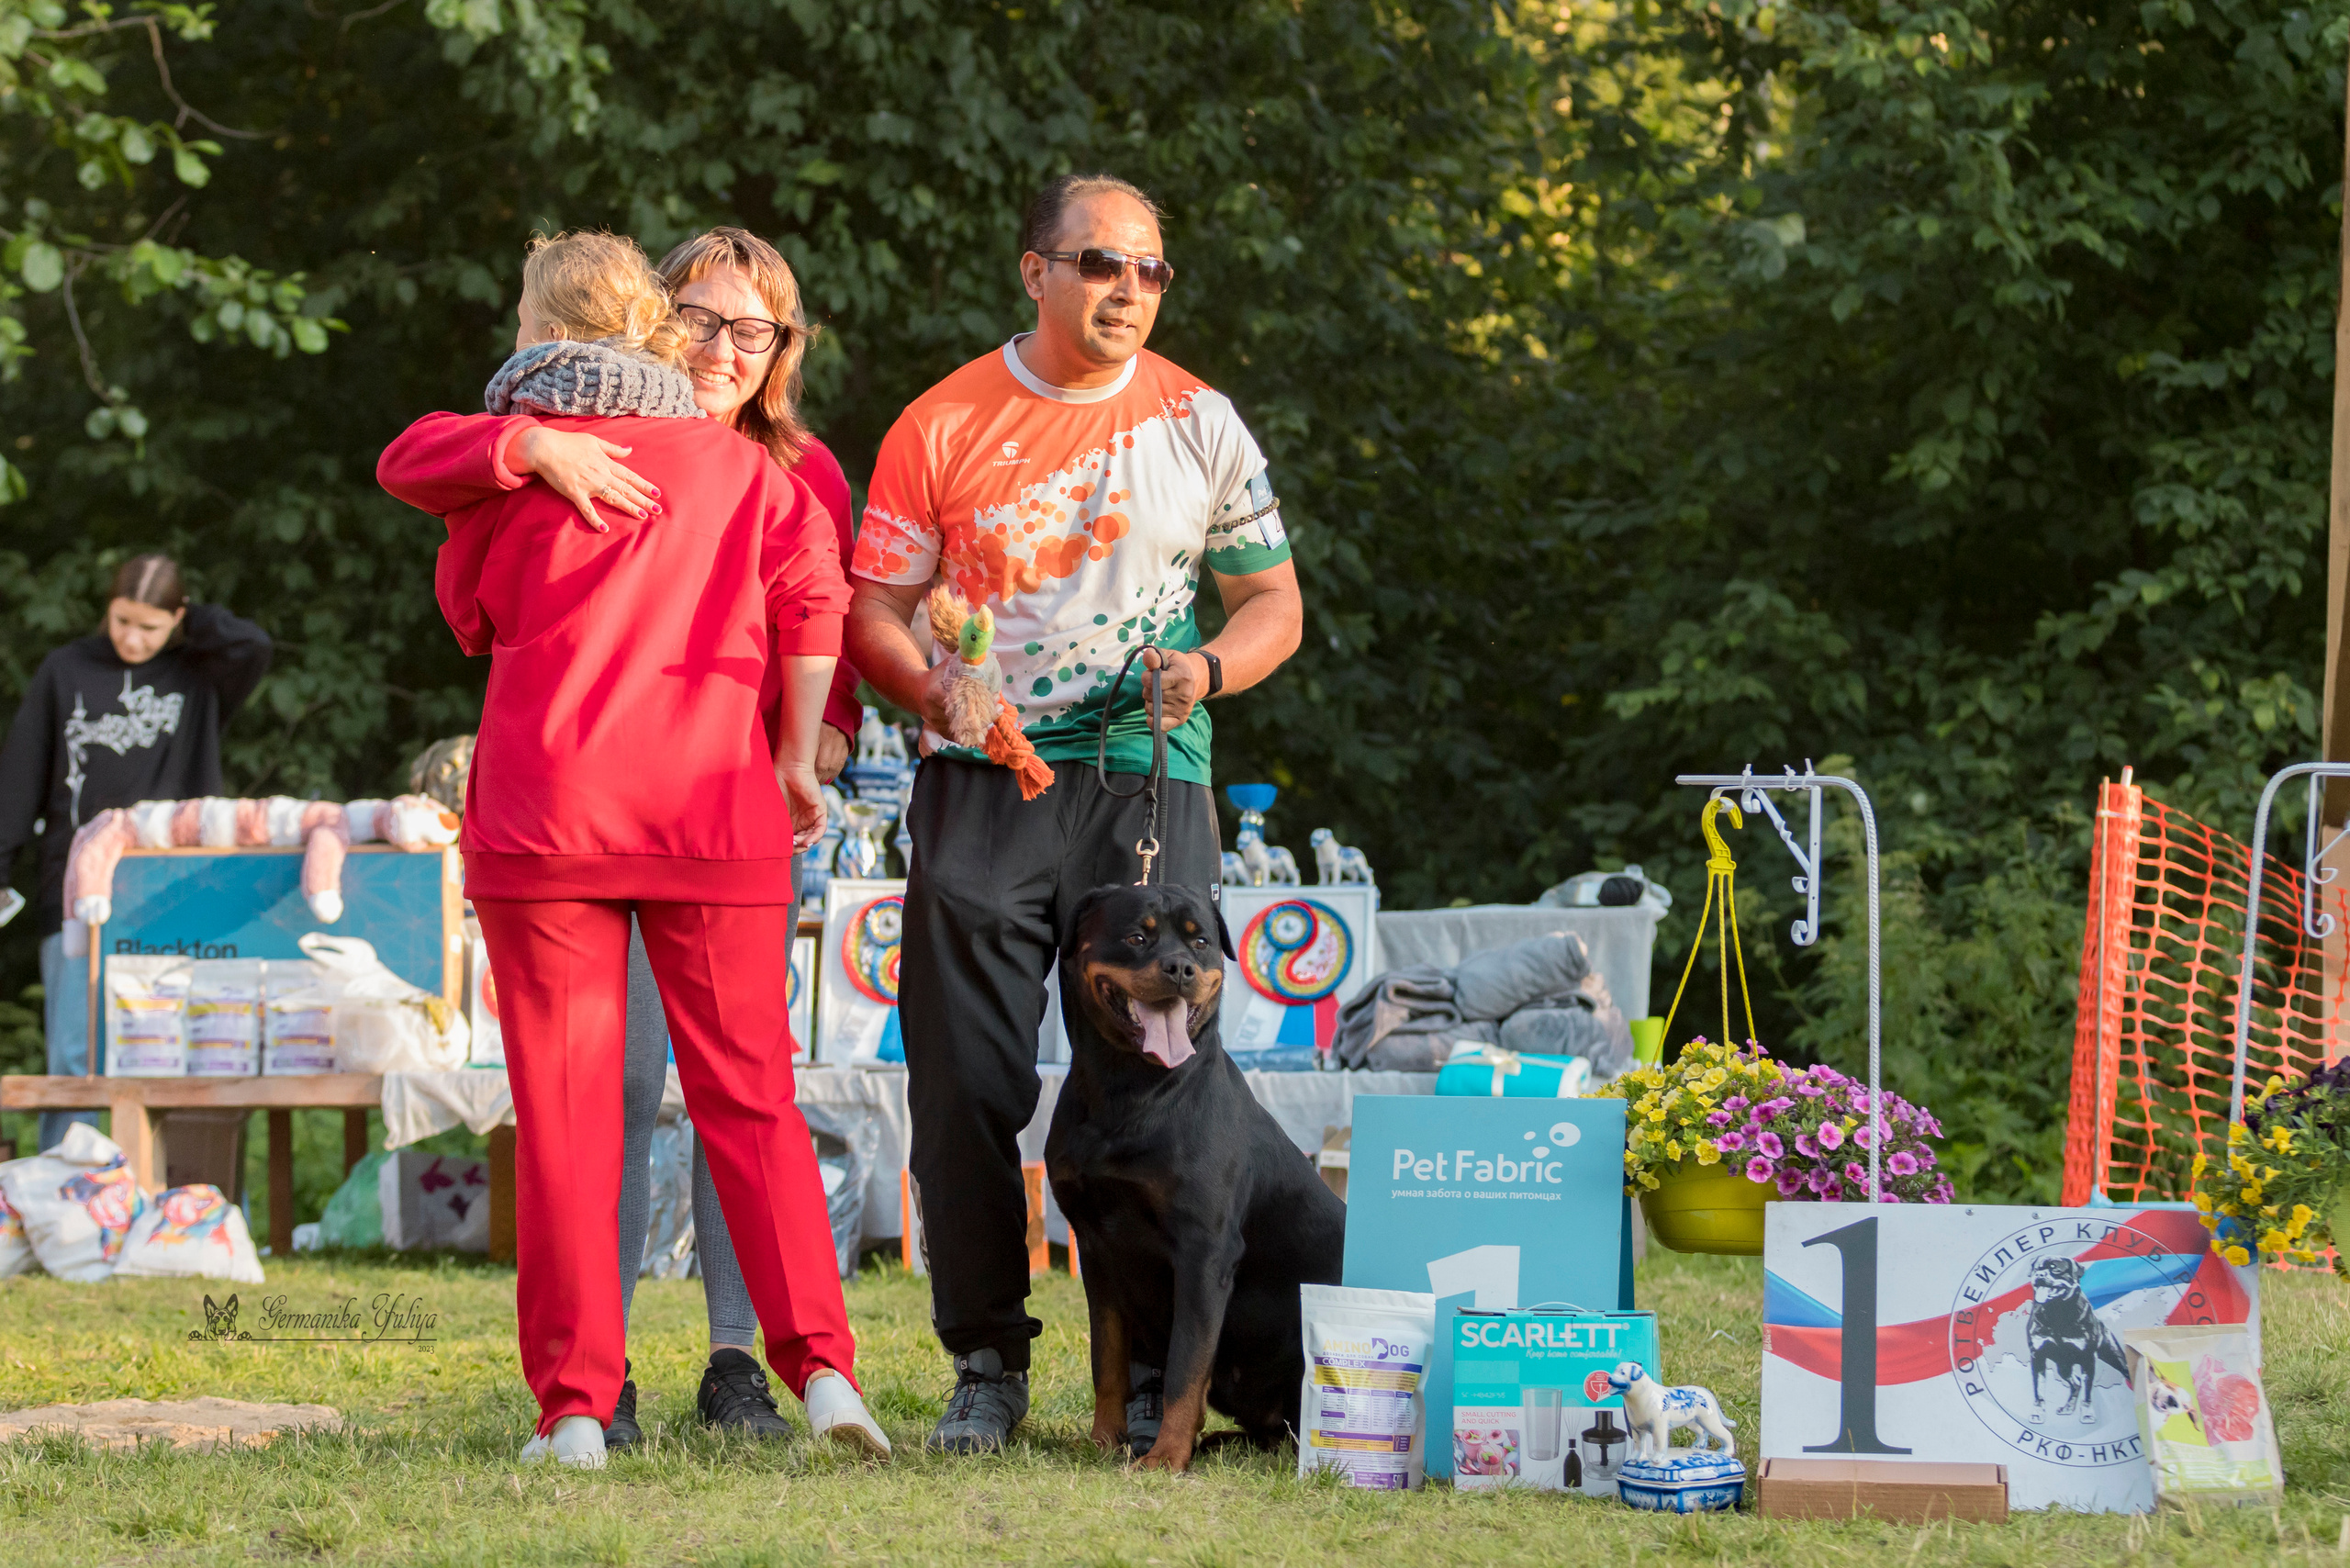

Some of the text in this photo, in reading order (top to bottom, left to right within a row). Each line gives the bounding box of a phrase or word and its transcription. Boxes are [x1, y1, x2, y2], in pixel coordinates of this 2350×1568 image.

[992, 458, 1031, 467] TRIUMPH
[1393, 1148, 1563, 1183] Pet Fabric
[1392, 1189, 1424, 1199] умная
[1426, 1188, 1462, 1199] забота
[1472, 1191, 1507, 1199] ваших
[1509, 1191, 1562, 1202] питомцах
[1954, 1226, 2054, 1396] РОТВЕЙЛЕР
[2076, 1223, 2166, 1263] КЛУБ
[1801, 1215, 1913, 1456] 1
[1322, 1358, 1366, 1368] COMPLEX
